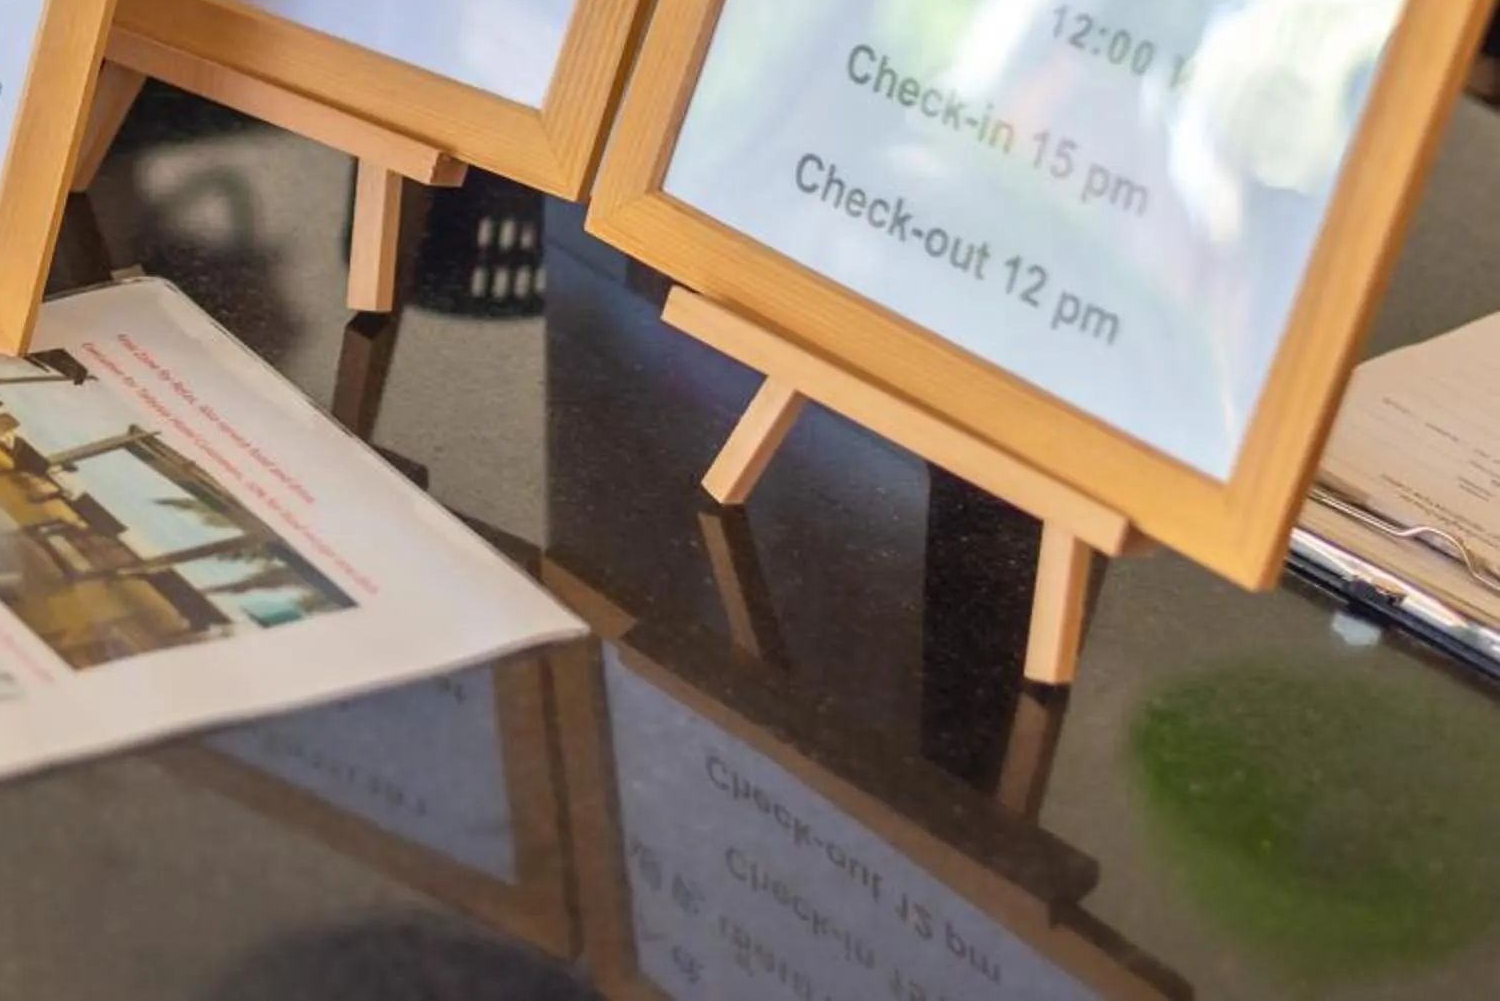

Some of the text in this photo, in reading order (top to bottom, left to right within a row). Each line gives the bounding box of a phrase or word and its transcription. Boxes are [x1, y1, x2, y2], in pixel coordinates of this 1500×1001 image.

[1052, 3, 1157, 76] 12:00
[846, 43, 1151, 218] Check-in 15 pm
[795, 152, 1121, 346] Check-out 12 pm
